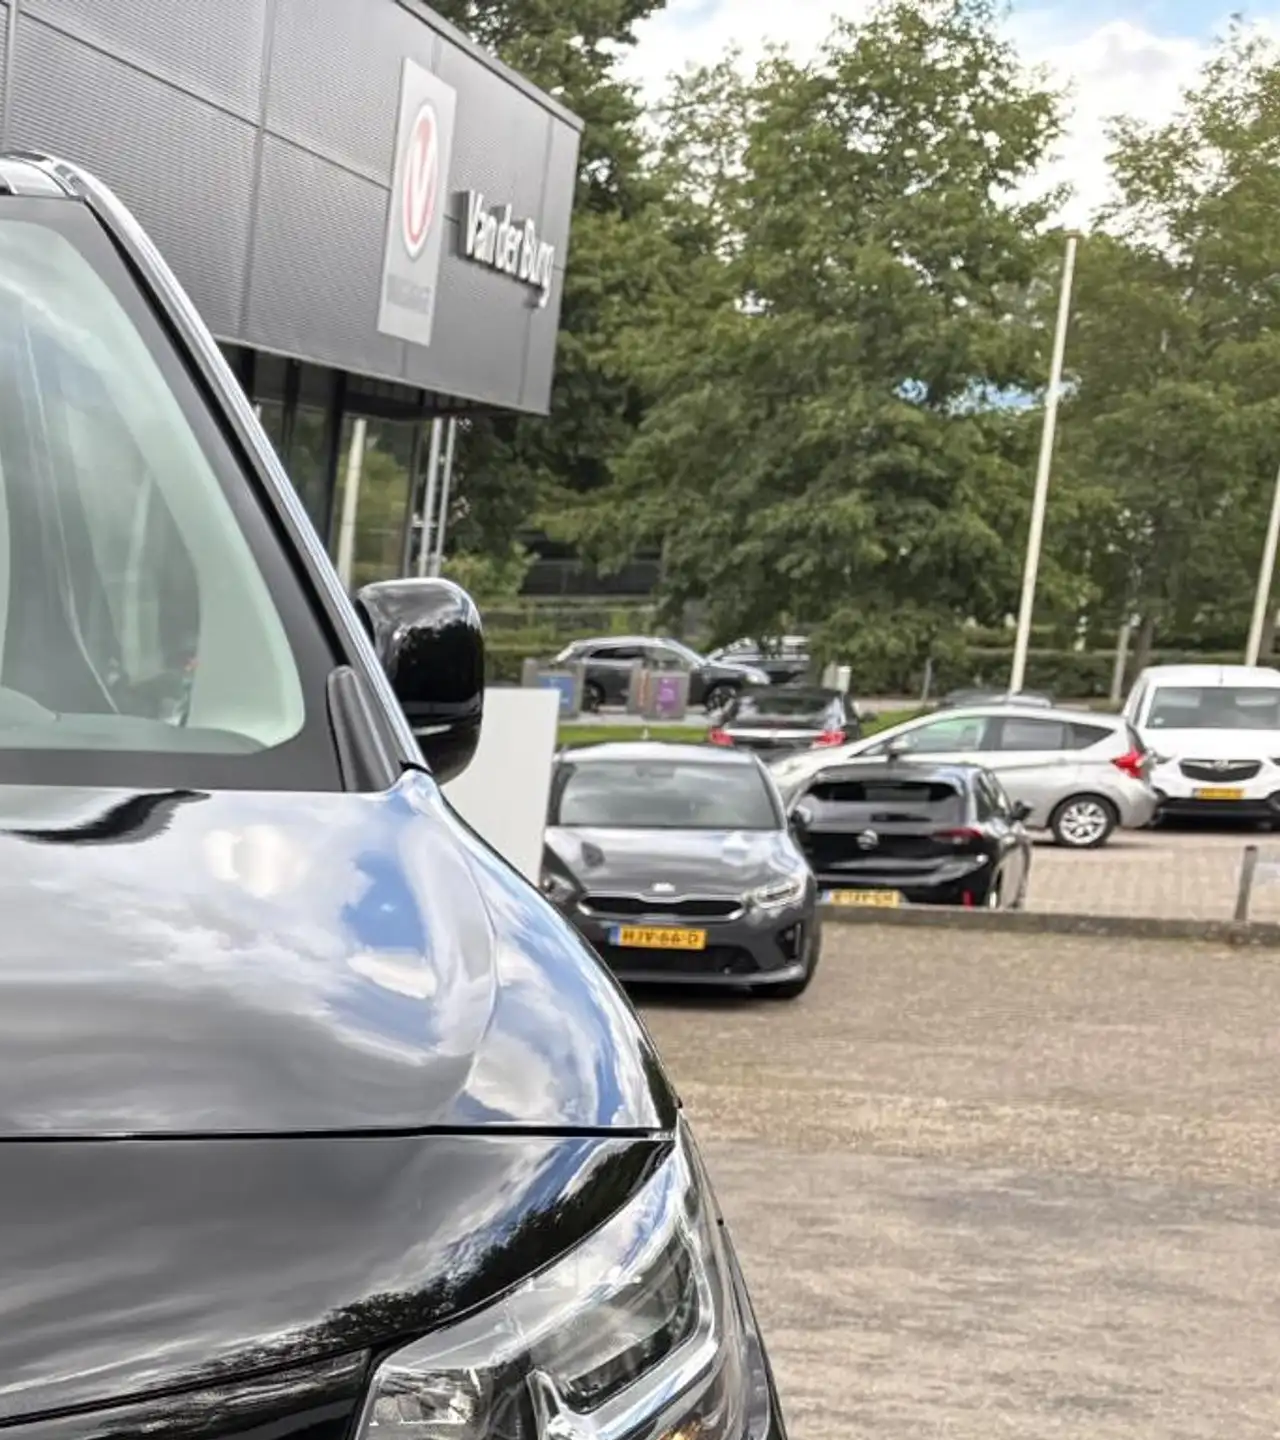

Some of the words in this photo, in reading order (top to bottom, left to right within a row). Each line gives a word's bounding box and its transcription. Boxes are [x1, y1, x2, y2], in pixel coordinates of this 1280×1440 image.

[466, 190, 497, 263] Van
[495, 203, 523, 274] der
[519, 217, 554, 308] Burg
